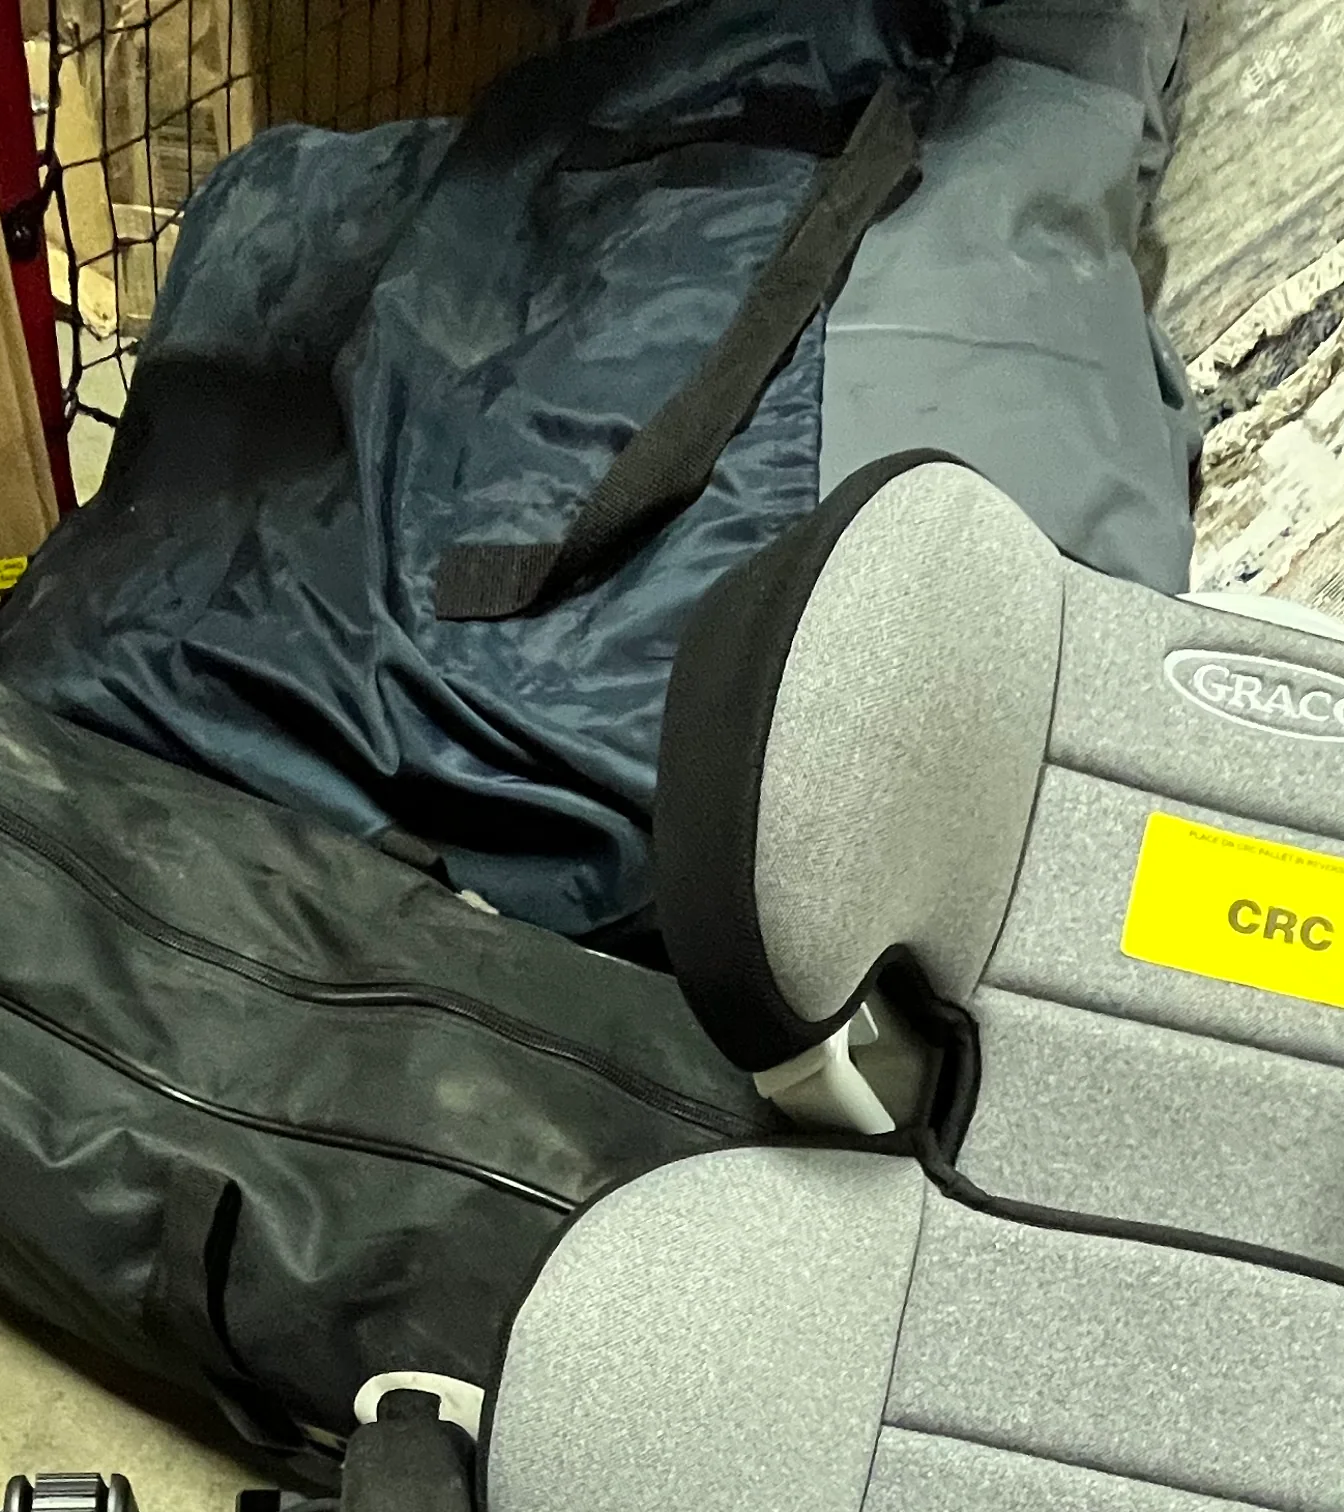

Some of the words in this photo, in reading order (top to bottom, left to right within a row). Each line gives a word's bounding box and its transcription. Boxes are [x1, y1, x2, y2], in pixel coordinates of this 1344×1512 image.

[1189, 830, 1218, 844] PLACE
[1222, 839, 1235, 848] ON
[1237, 842, 1256, 854] CRC
[1258, 848, 1293, 862] PALLET
[1295, 856, 1305, 865] IN
[1227, 899, 1334, 951] CRC
